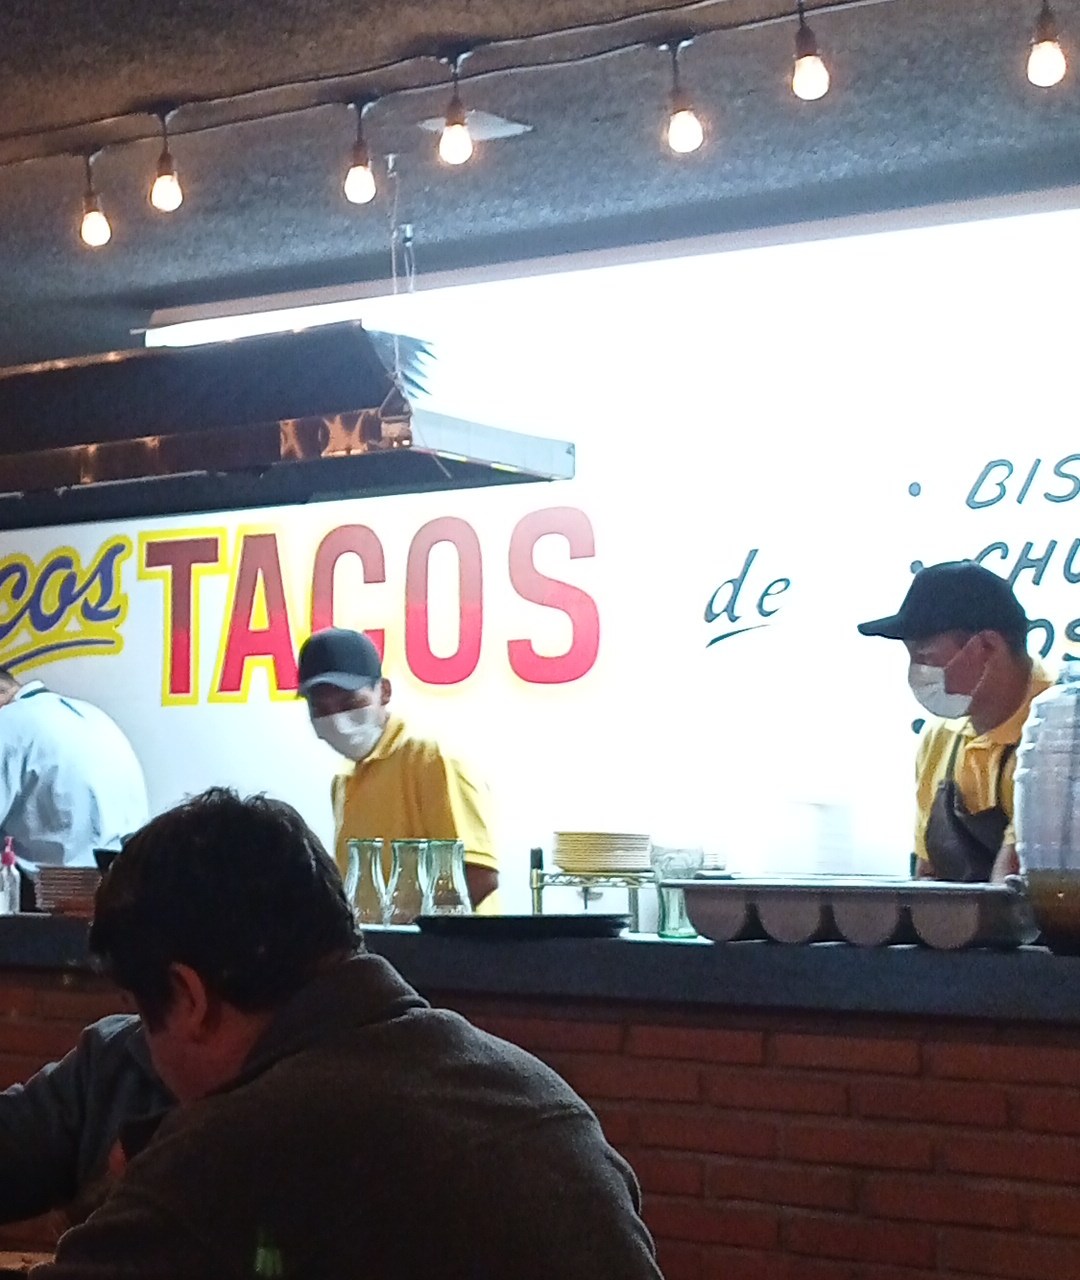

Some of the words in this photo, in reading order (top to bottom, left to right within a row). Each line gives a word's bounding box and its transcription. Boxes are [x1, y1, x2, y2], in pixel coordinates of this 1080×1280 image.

[965, 453, 1080, 510] BIS
[144, 506, 601, 695] TACOS
[704, 548, 791, 624] de
